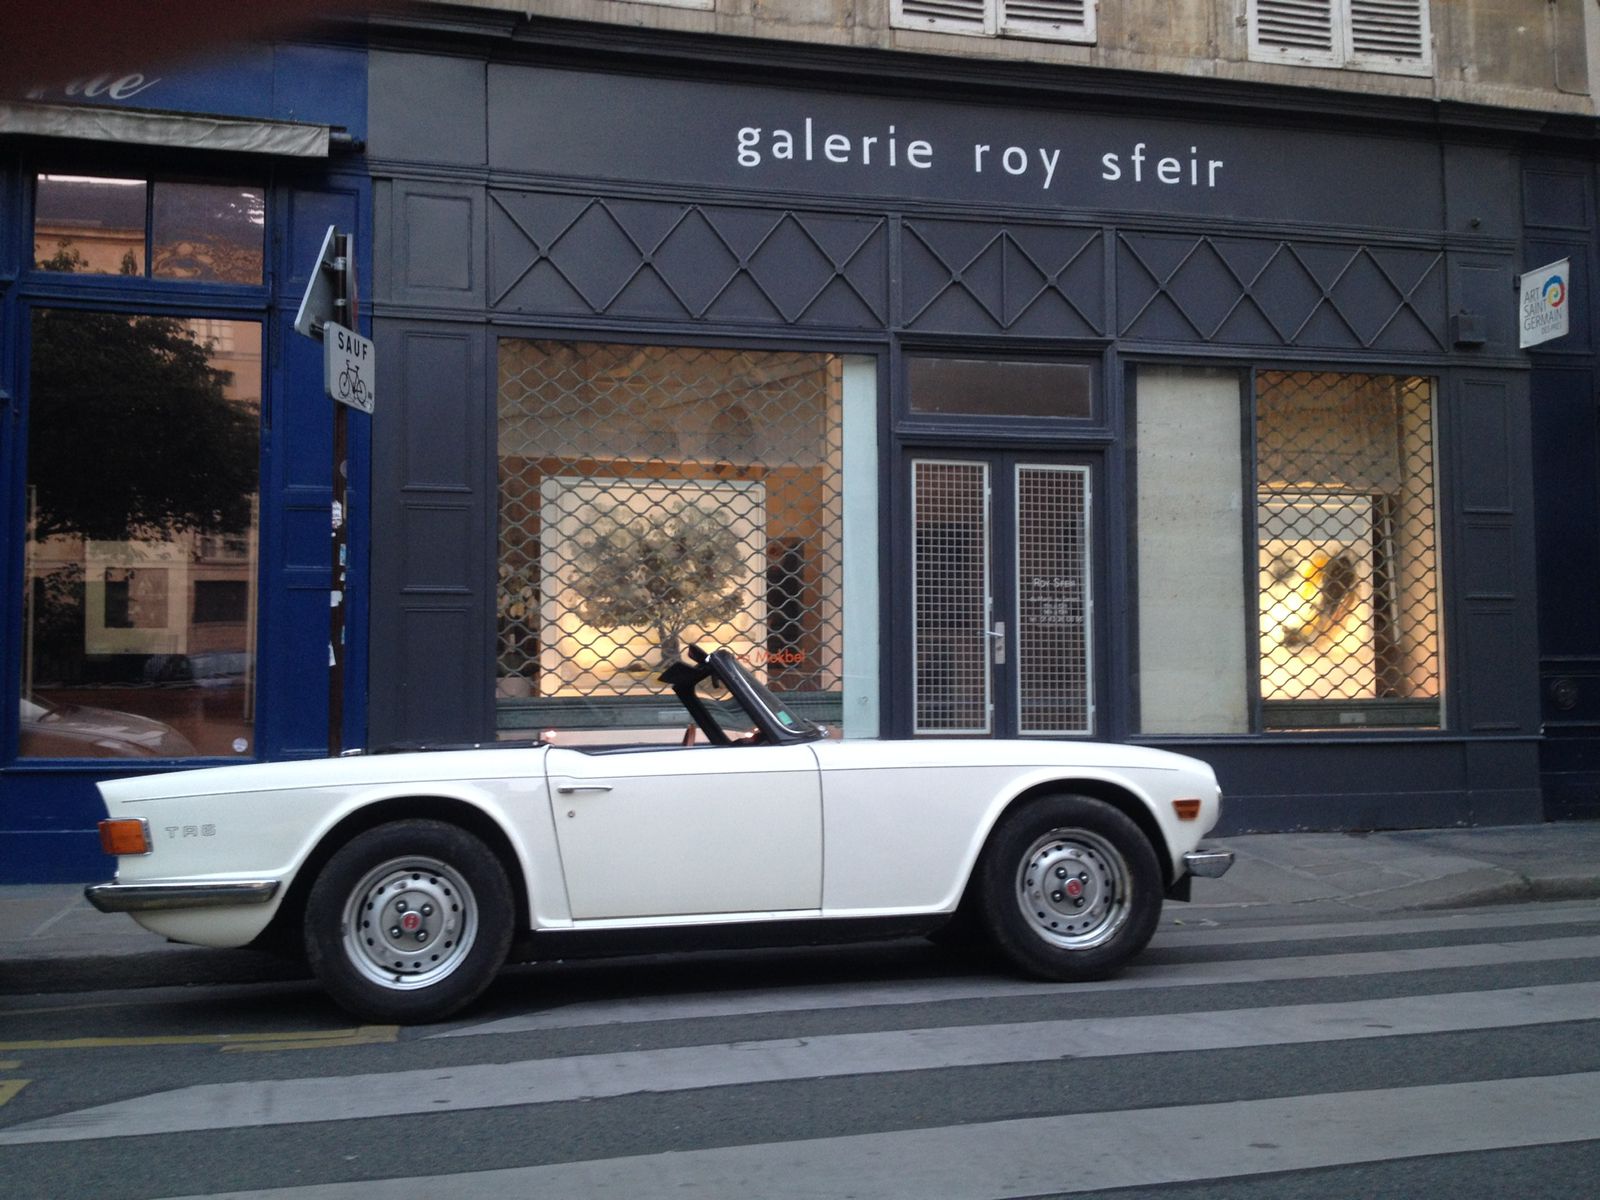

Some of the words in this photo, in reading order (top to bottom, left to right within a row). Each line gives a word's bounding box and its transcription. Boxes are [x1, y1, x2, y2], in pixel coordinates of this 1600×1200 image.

[737, 118, 933, 169] galerie
[974, 145, 1061, 190] roy
[1102, 143, 1224, 187] sfeir
[1524, 287, 1541, 304] ART
[1524, 299, 1547, 318] SAINT
[1524, 308, 1562, 332] GERMAIN
[338, 331, 368, 361] SAUF
[165, 824, 217, 839] TR6
